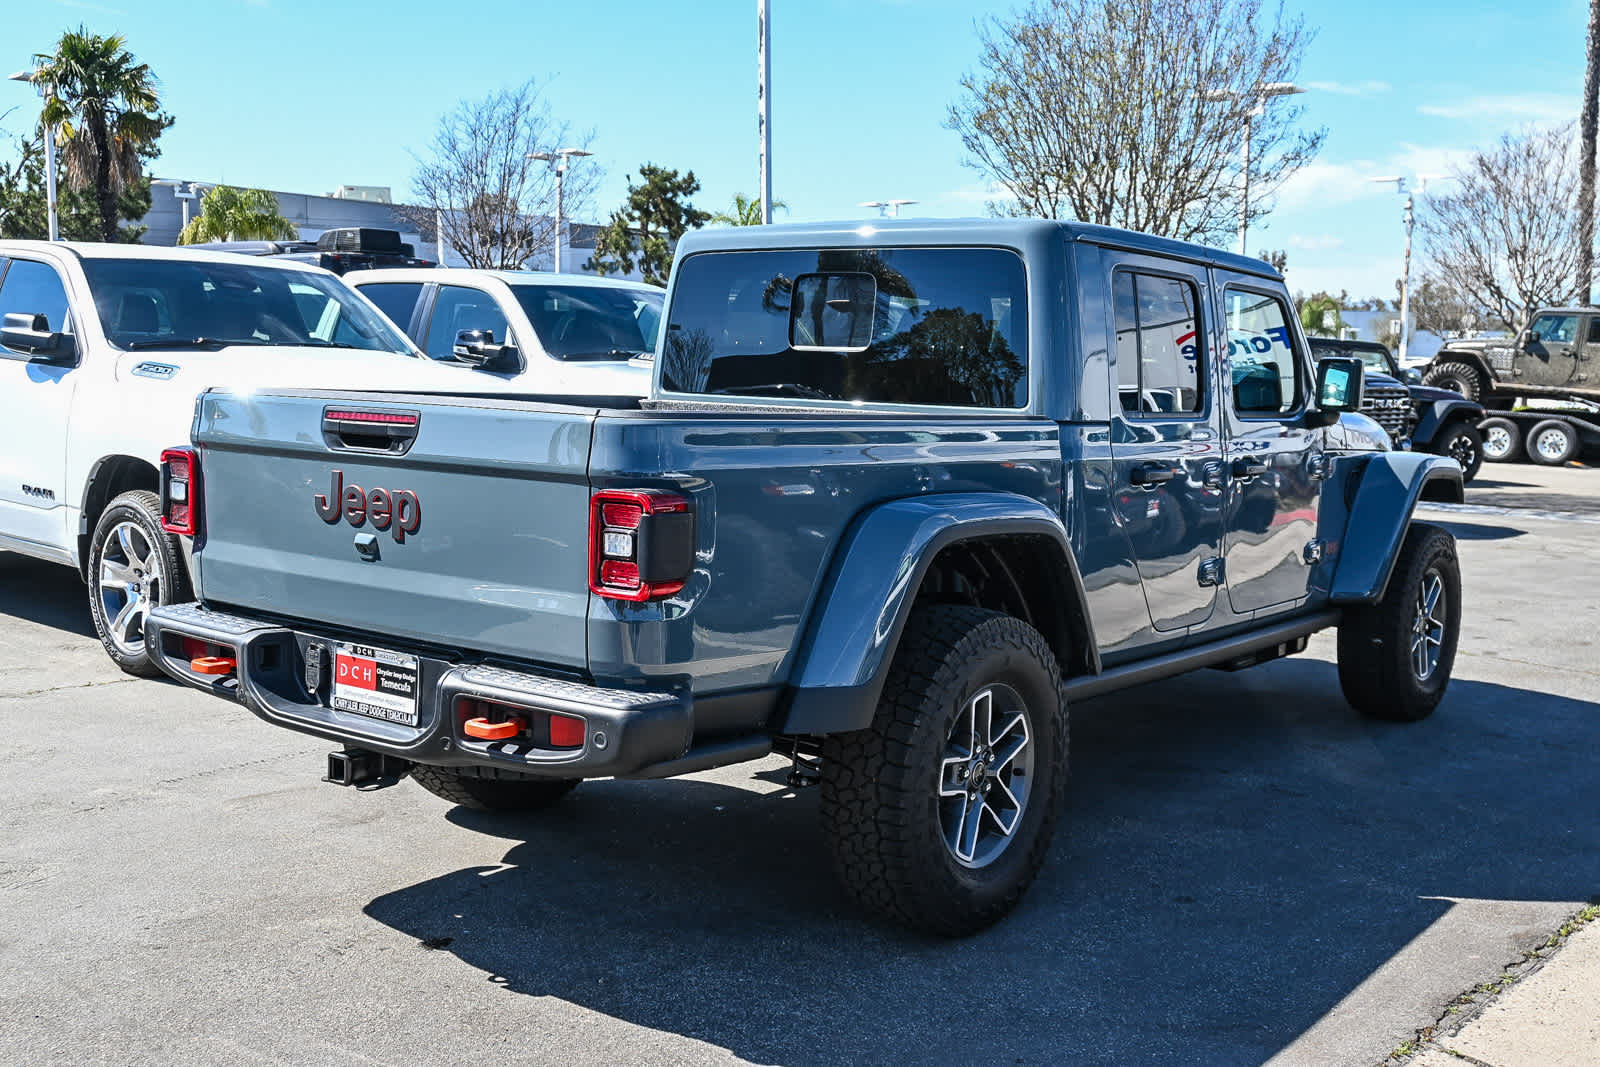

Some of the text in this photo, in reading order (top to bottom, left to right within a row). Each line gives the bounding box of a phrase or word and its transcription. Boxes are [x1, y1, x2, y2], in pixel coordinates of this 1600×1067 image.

[22, 484, 55, 500] RAM
[314, 470, 421, 543] Jeep
[380, 677, 411, 692] Temecula
[335, 697, 358, 711] CHRYSLER
[369, 705, 386, 718] DODGE
[387, 709, 412, 724] TEMECULA
